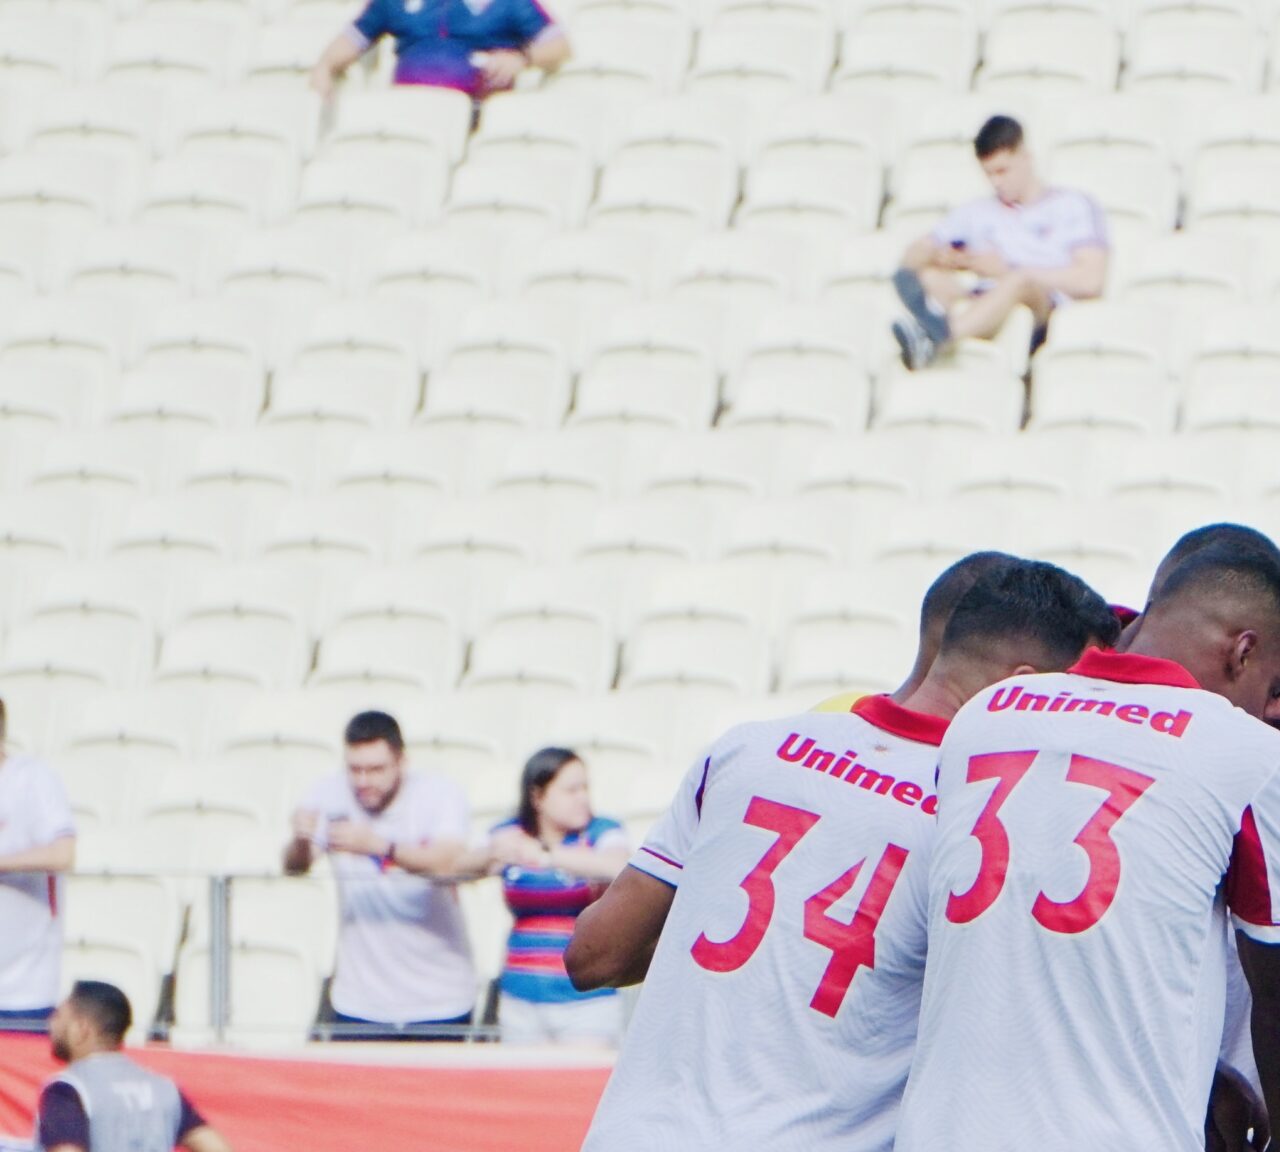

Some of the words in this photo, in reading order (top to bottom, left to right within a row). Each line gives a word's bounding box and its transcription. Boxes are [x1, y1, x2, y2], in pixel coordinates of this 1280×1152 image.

[987, 685, 1192, 739] Unimed
[690, 796, 909, 1019] 34
[945, 750, 1155, 934] 33
